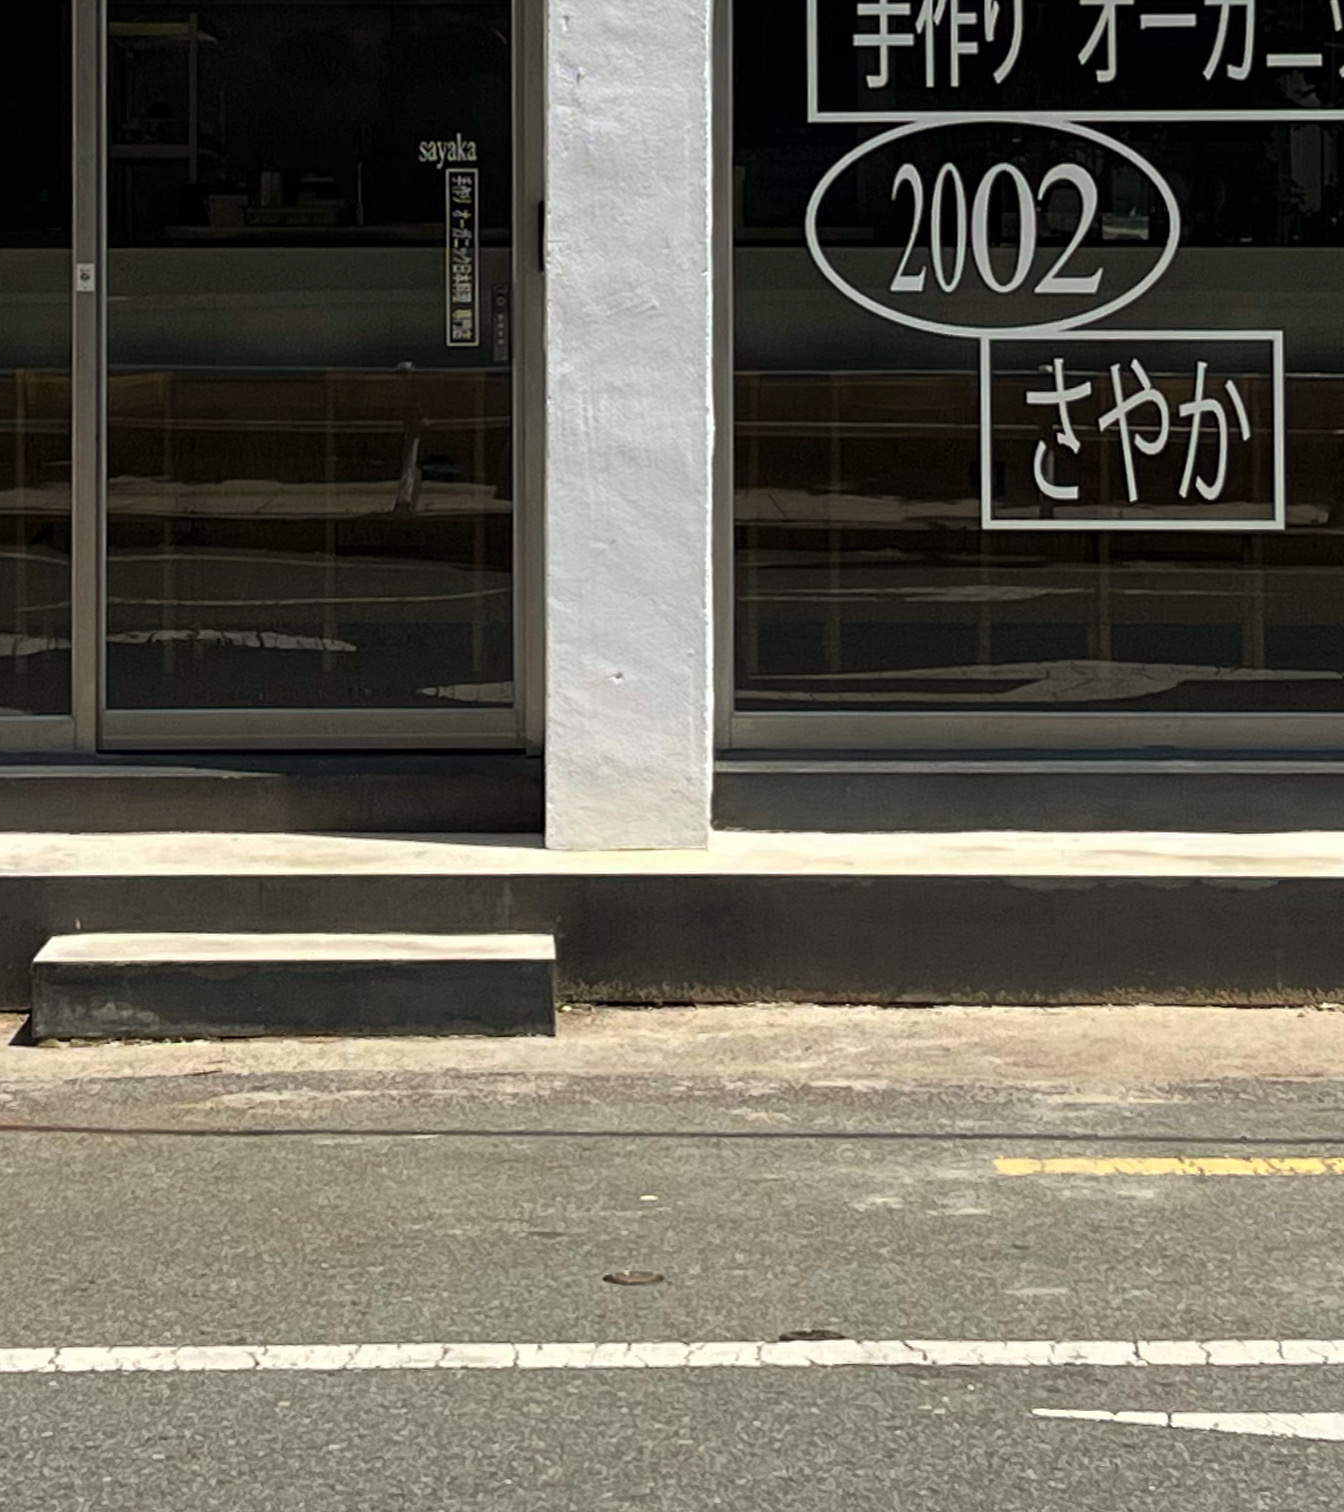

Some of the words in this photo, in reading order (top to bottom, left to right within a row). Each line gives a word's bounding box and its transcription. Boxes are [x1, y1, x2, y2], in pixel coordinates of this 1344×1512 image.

[418, 132, 477, 169] sayaka
[889, 161, 1104, 294] 2002
[1026, 357, 1251, 502] さやか
